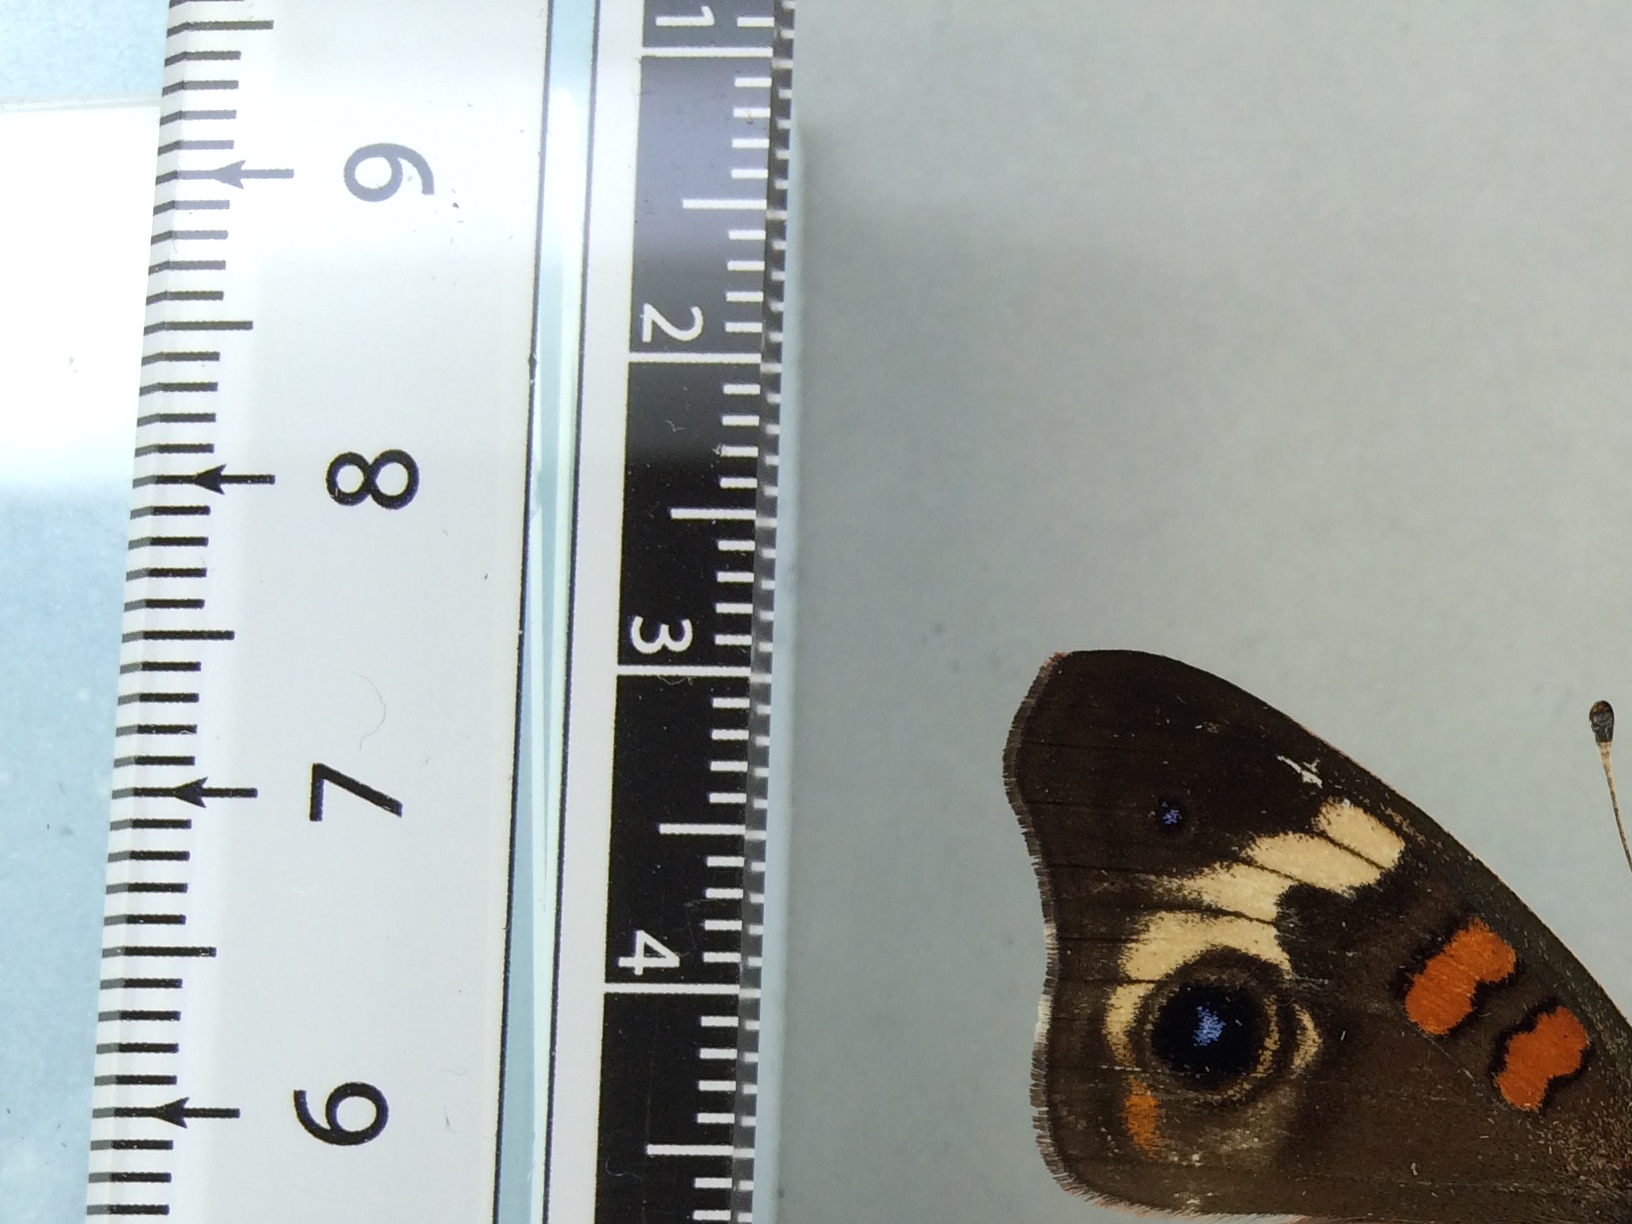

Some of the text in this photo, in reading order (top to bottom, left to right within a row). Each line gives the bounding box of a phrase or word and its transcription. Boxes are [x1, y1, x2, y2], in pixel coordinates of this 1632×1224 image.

[656, 6, 714, 27] 1
[344, 142, 434, 203] 9
[640, 304, 704, 343] 2
[326, 449, 420, 511] 8
[631, 616, 693, 655] 3
[309, 763, 403, 822] 7
[618, 930, 681, 976] 4
[294, 1082, 389, 1147] 6
